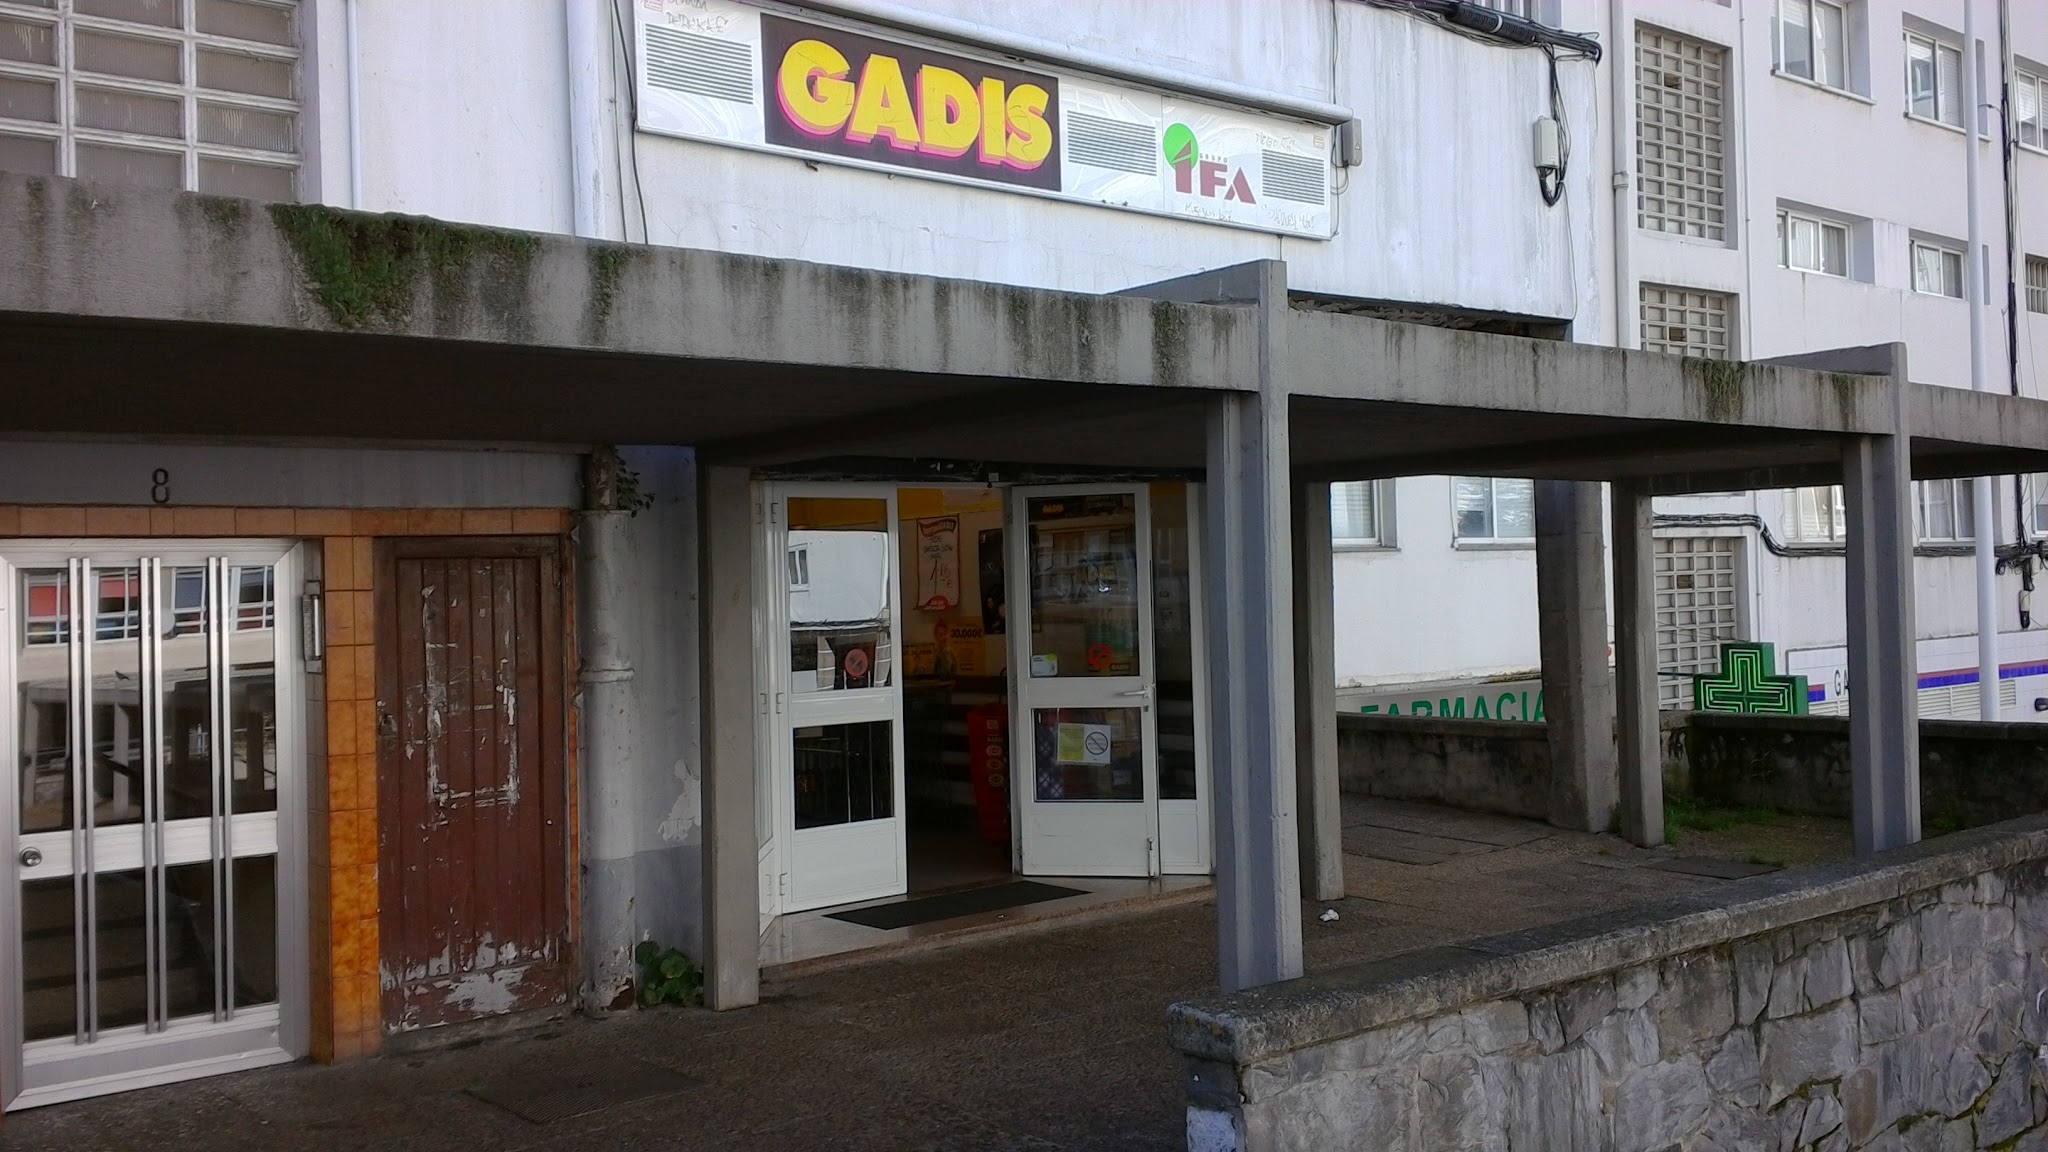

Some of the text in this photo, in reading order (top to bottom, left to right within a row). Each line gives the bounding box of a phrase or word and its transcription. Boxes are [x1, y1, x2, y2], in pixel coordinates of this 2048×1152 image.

[777, 40, 1053, 169] GADIS
[1172, 139, 1257, 205] IFA
[1199, 152, 1228, 163] GRUPO
[151, 467, 171, 504] 8
